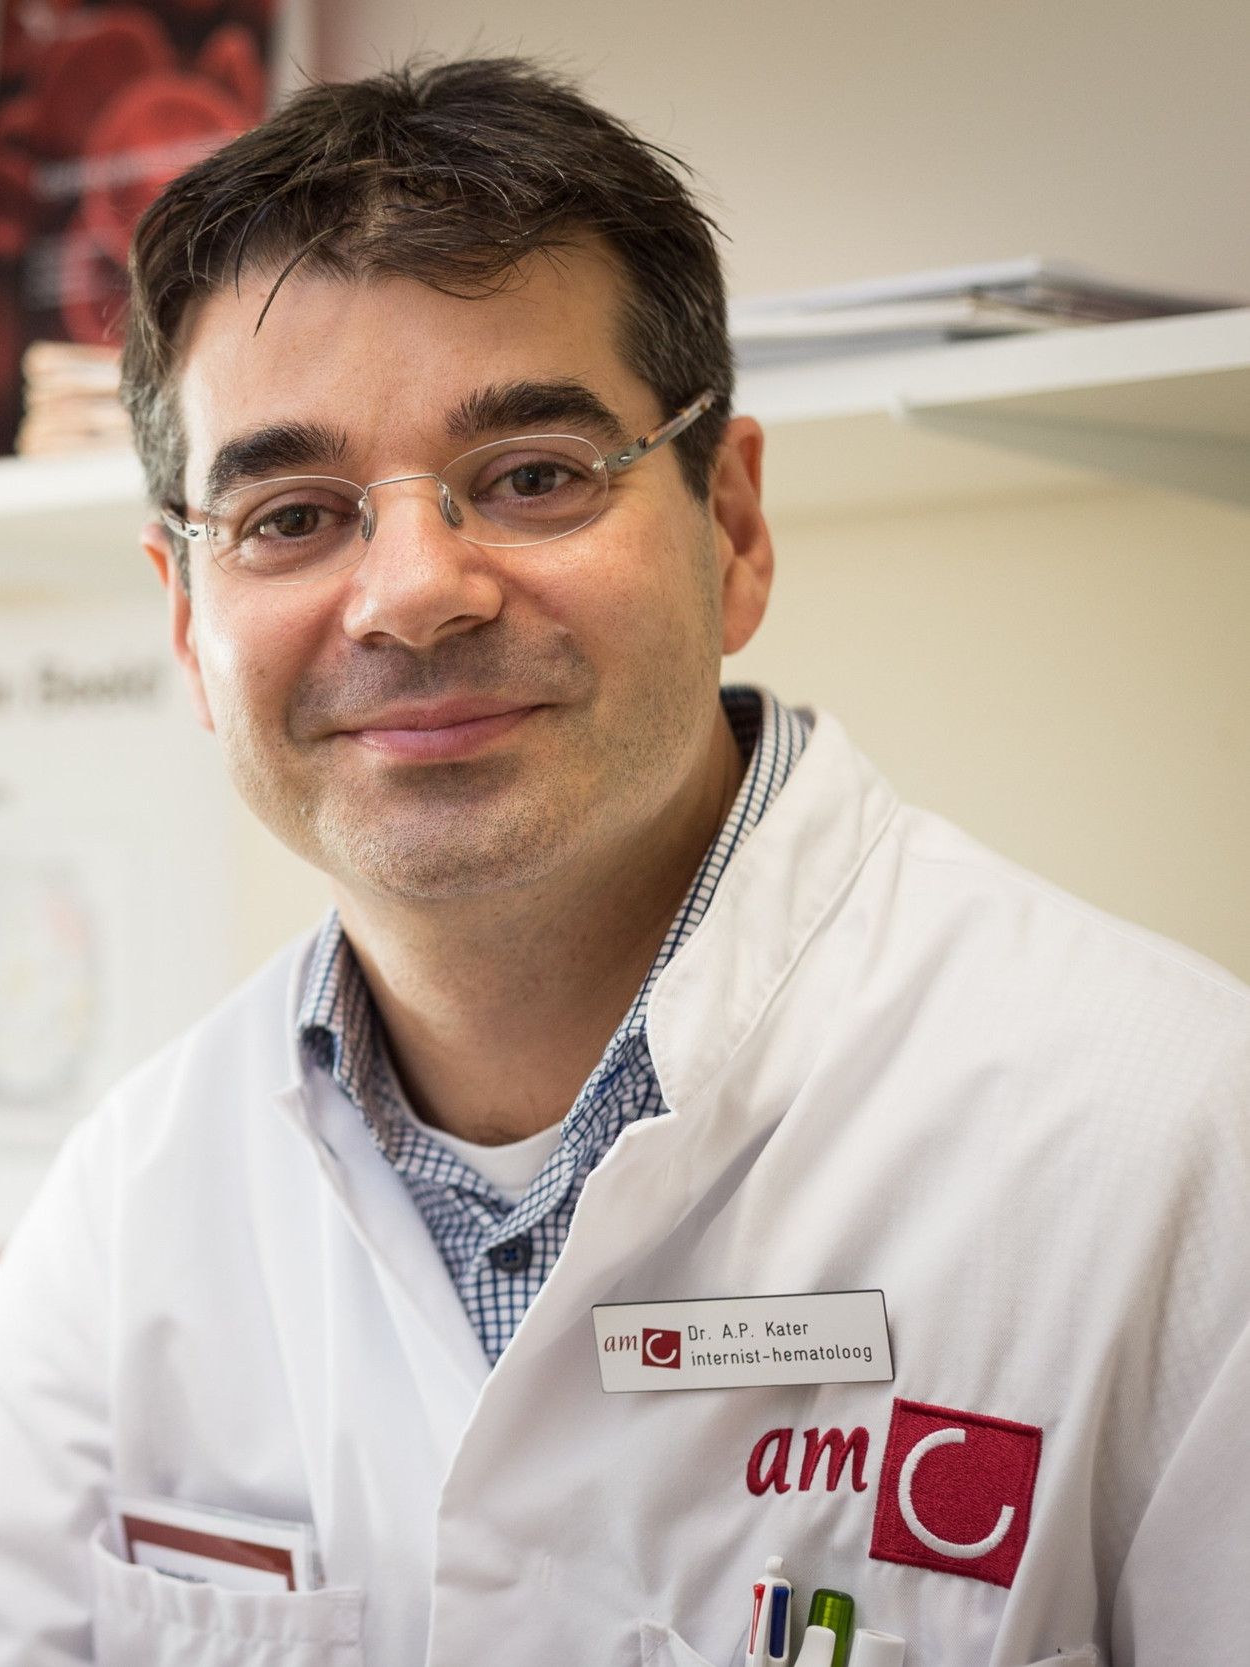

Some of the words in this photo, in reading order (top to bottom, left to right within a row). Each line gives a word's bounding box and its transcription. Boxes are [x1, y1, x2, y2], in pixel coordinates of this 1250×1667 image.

[687, 1325, 711, 1341] Dr.
[722, 1322, 754, 1339] A.P.
[765, 1321, 809, 1337] Kater
[690, 1344, 873, 1366] internist-hematoloog
